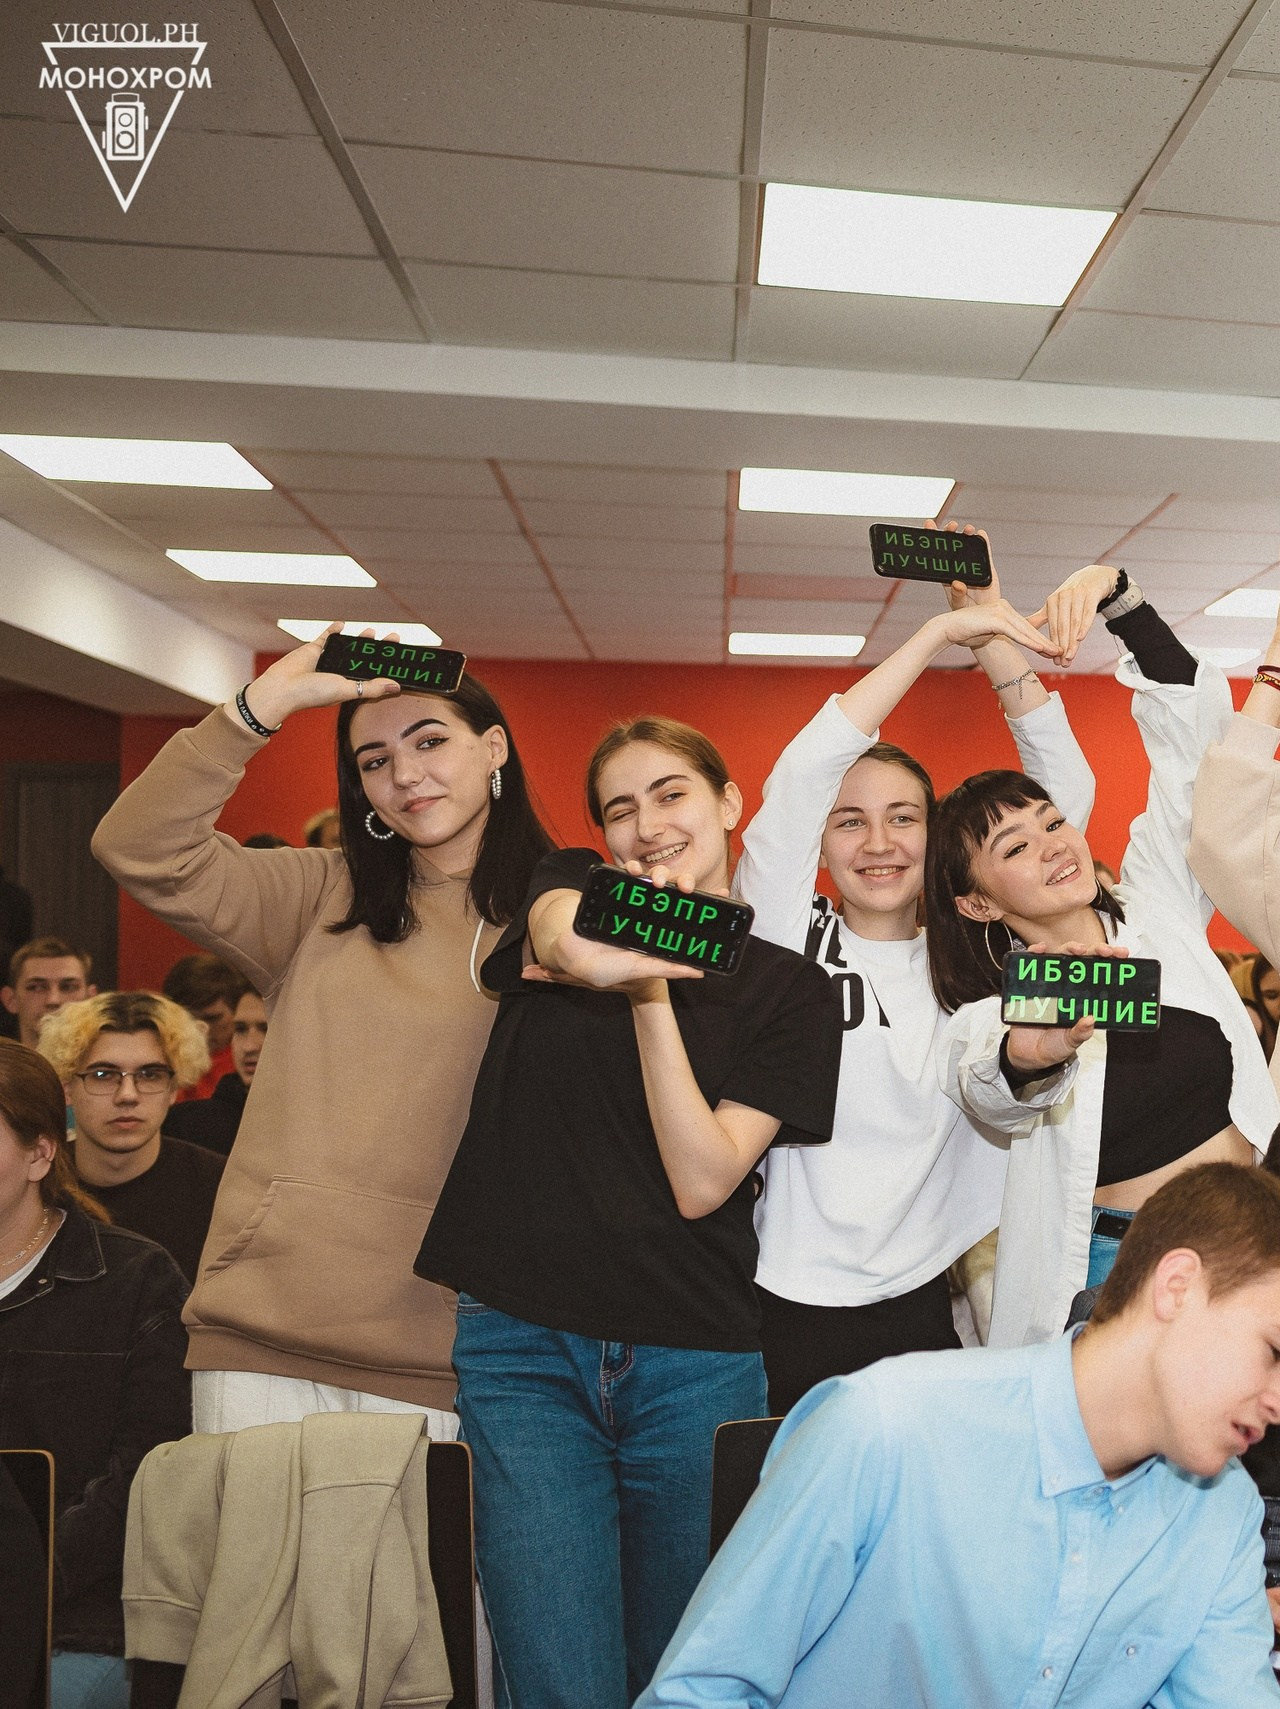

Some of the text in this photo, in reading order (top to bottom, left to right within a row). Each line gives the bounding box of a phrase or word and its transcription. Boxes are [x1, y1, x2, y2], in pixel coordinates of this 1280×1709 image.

[885, 531, 964, 552] ИБЭПР
[881, 552, 983, 576] ЛУЧШИЕ
[346, 659, 443, 684] УЧШИЕ
[599, 912, 723, 963] УЧШИЕ
[1018, 958, 1137, 986] ИБЭПР
[1006, 995, 1158, 1025] ЛУЧШИЕ
